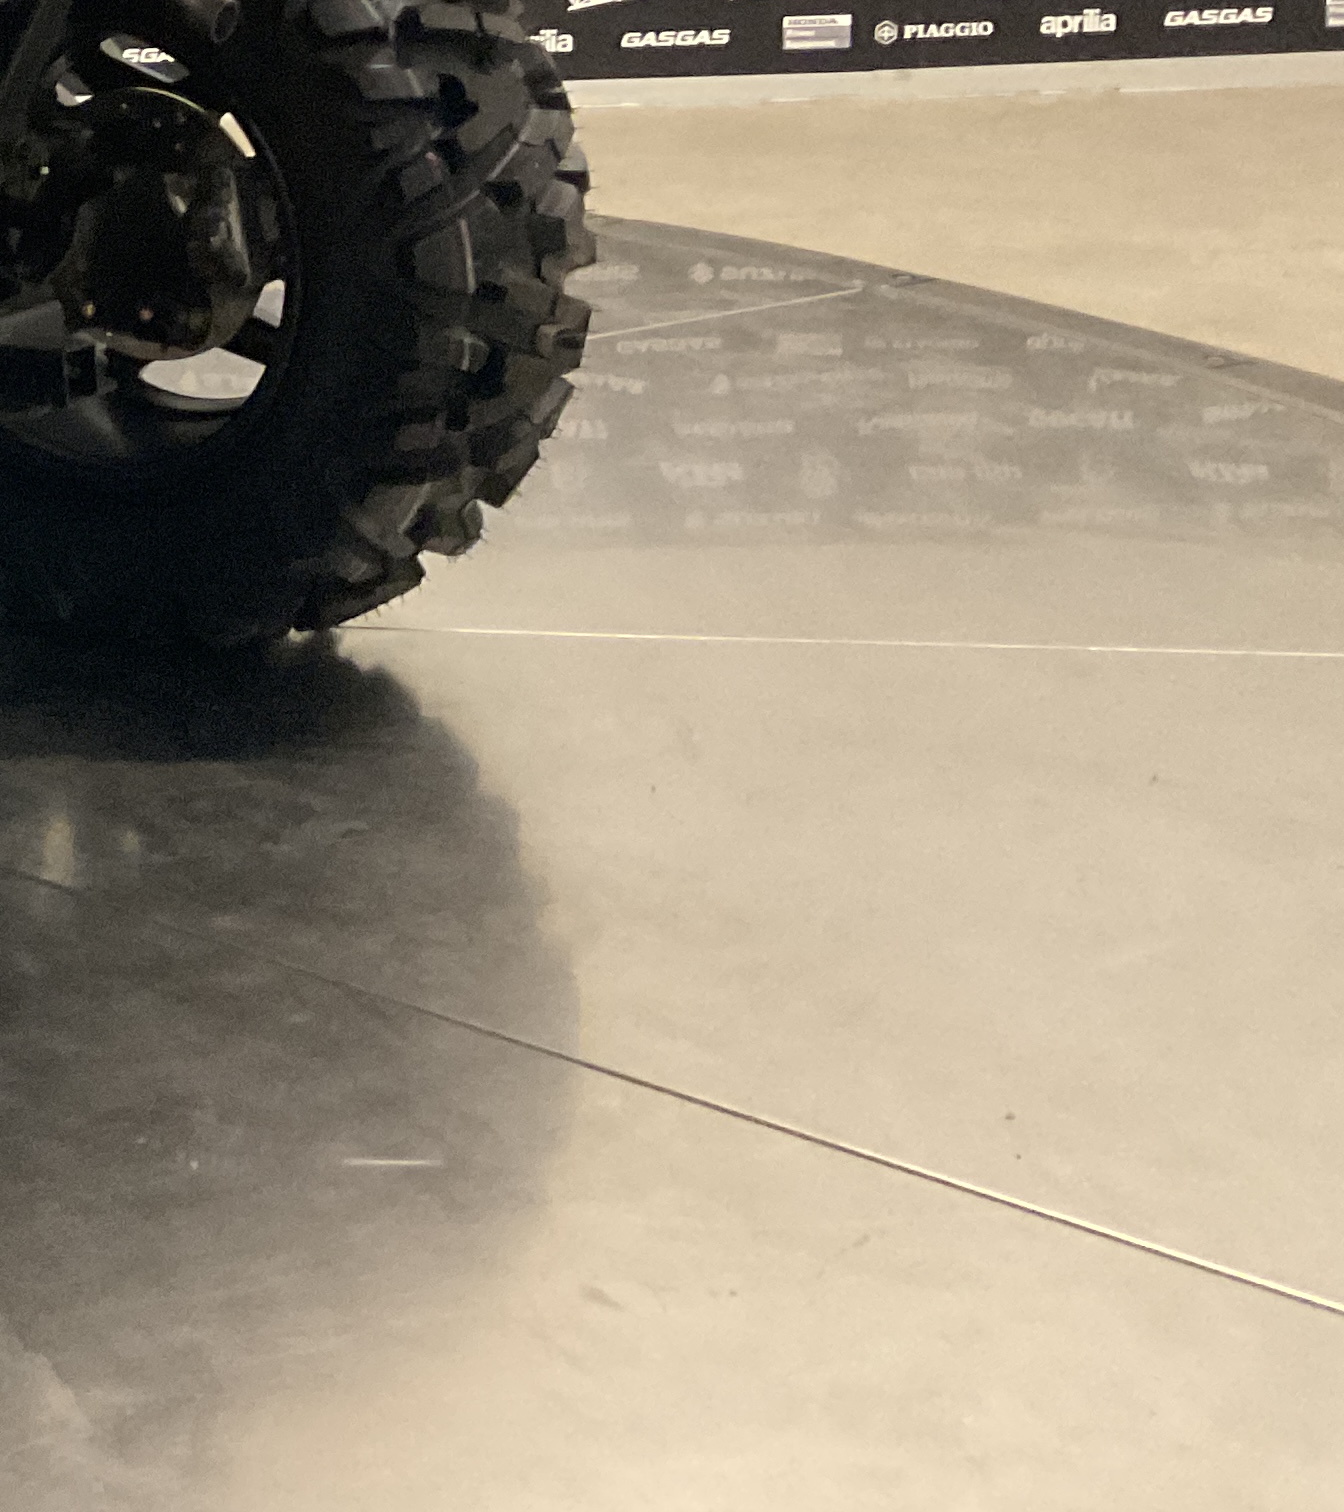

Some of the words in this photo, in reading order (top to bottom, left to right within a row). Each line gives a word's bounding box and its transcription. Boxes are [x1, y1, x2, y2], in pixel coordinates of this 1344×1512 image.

[1040, 8, 1116, 38] aprilia
[1164, 7, 1273, 26] GASGAS
[621, 29, 731, 48] GASGAS
[903, 21, 993, 39] PIAGGIO
